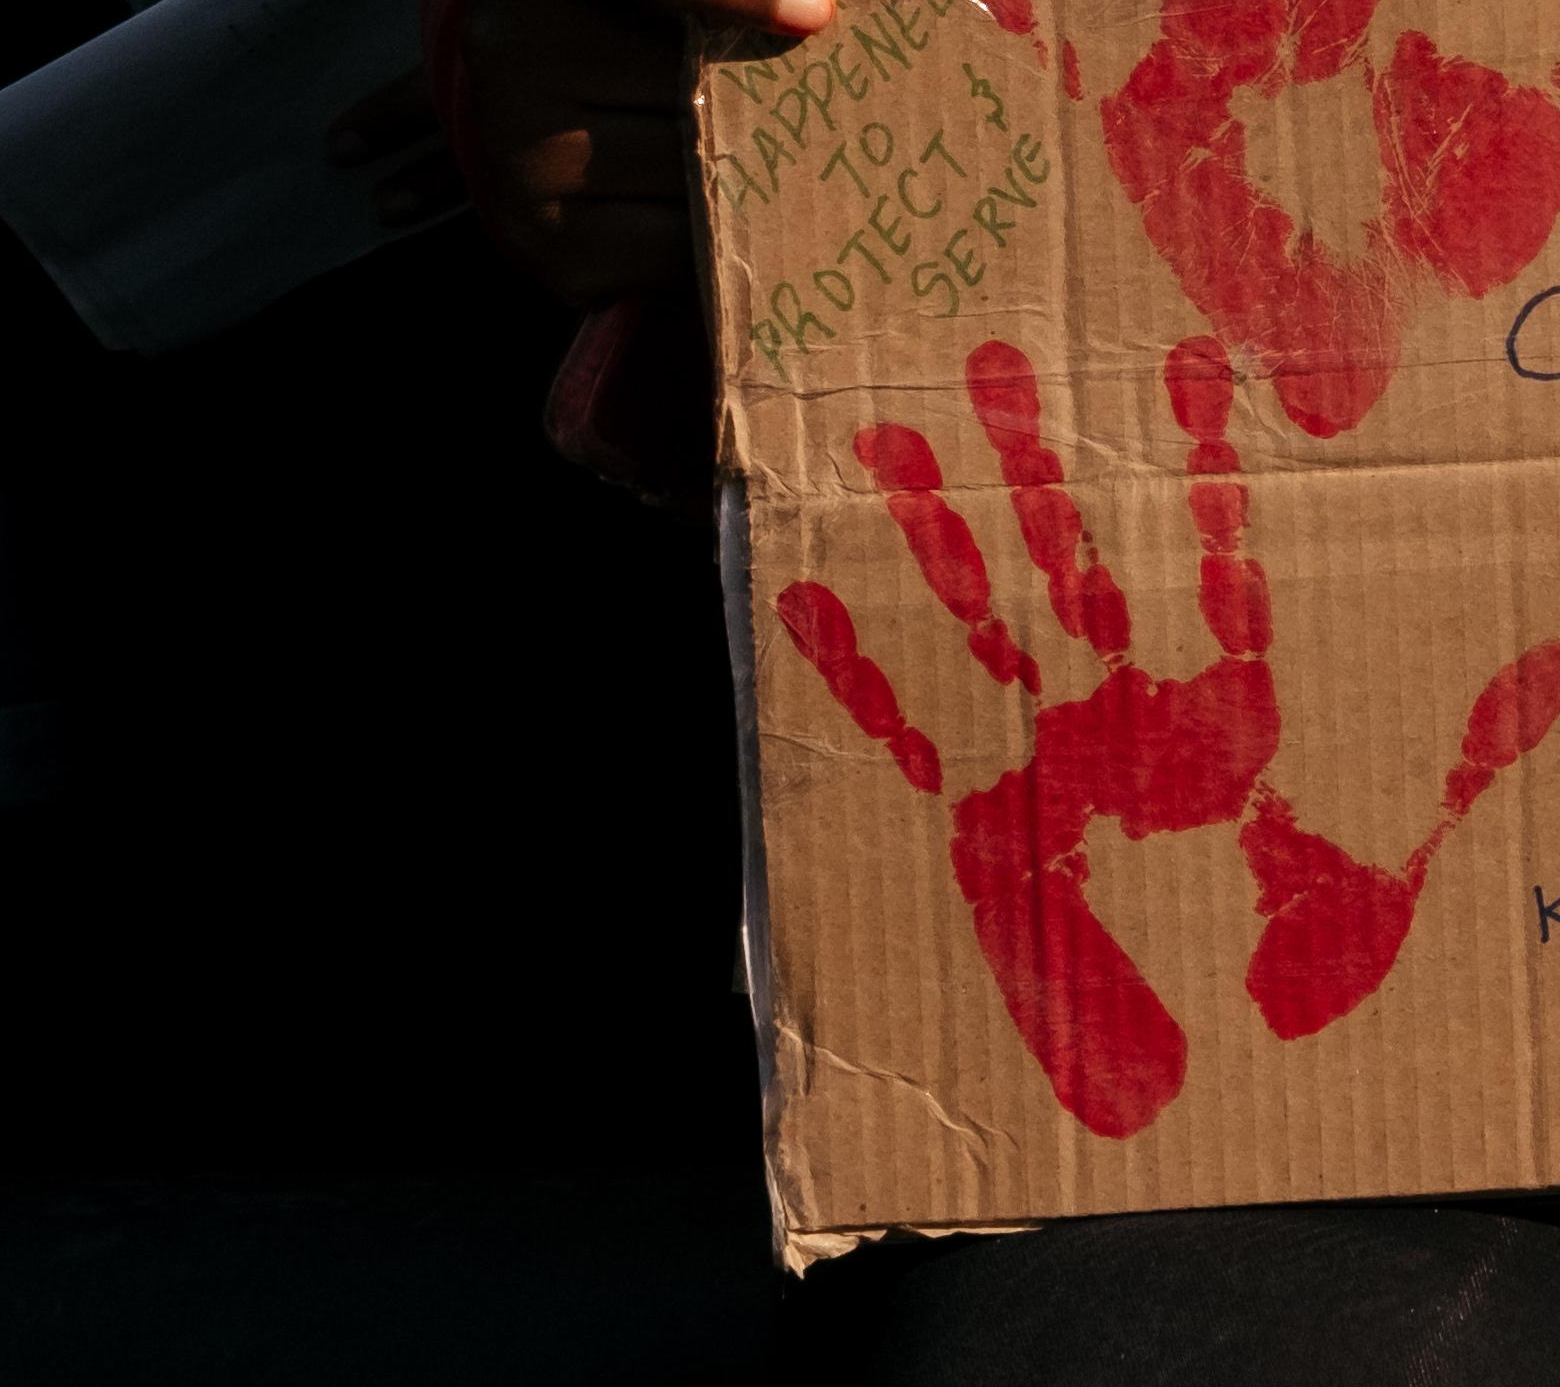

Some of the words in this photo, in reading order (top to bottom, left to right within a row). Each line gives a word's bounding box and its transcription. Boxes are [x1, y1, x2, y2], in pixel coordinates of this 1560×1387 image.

[819, 121, 894, 199] TO
[909, 132, 1051, 318] SERVE
[749, 129, 968, 381] PROTECT
